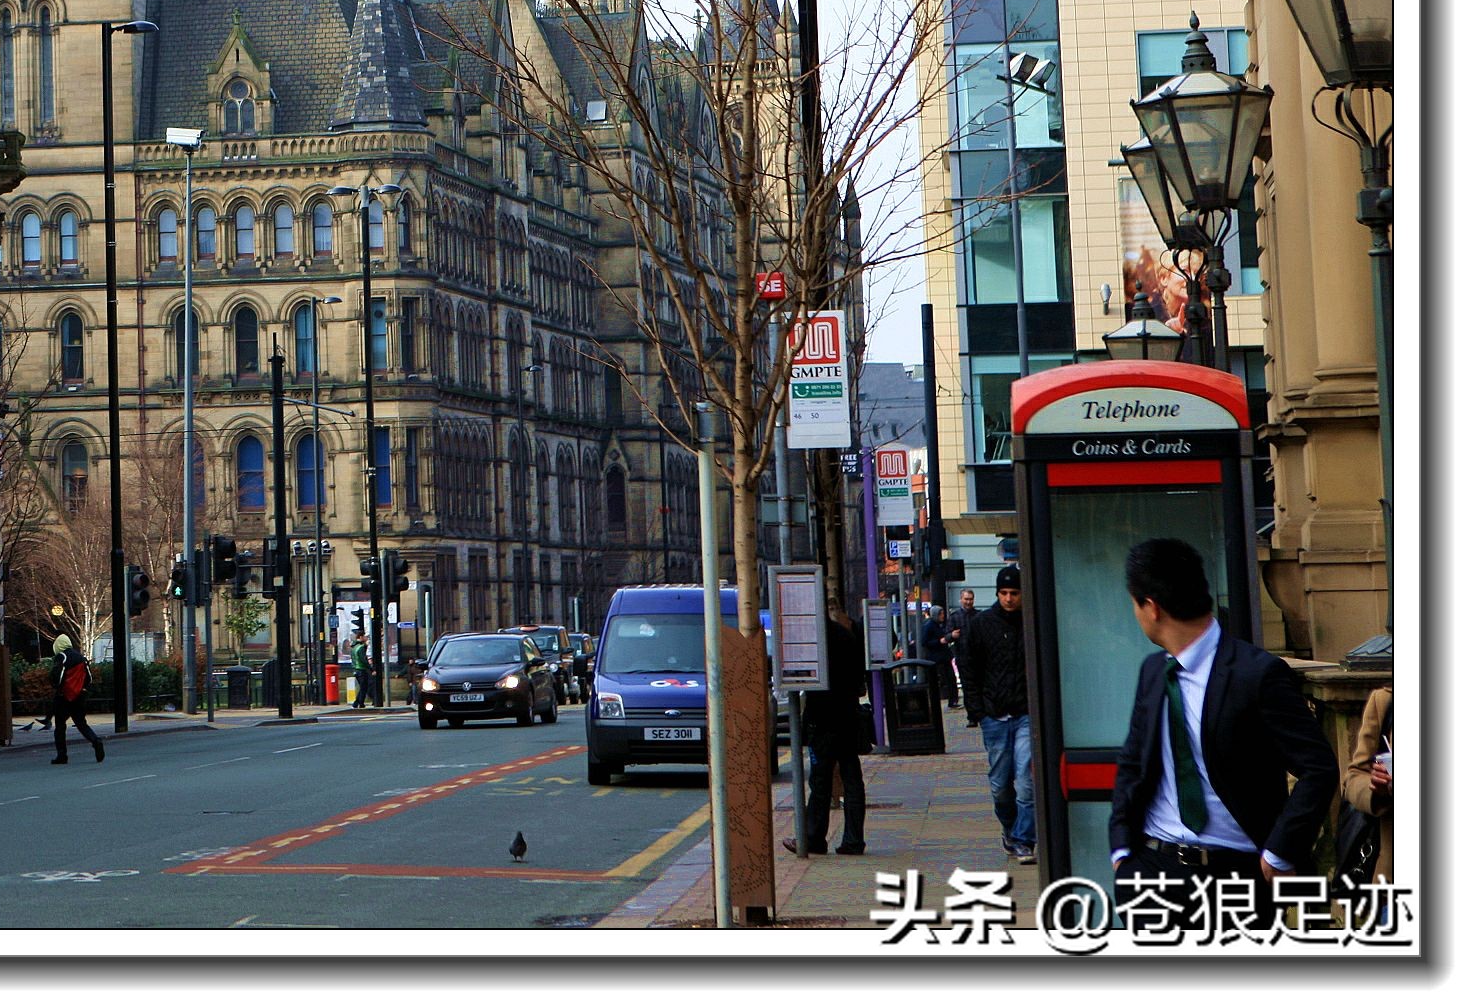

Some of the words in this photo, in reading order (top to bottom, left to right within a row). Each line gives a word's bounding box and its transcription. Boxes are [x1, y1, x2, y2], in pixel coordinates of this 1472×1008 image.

[791, 366, 842, 378] GMPTE
[1082, 400, 1181, 423] Telephone
[1071, 440, 1118, 456] Coins
[1121, 440, 1138, 455] &
[1141, 439, 1191, 455] Cards
[651, 729, 671, 739] SEZ
